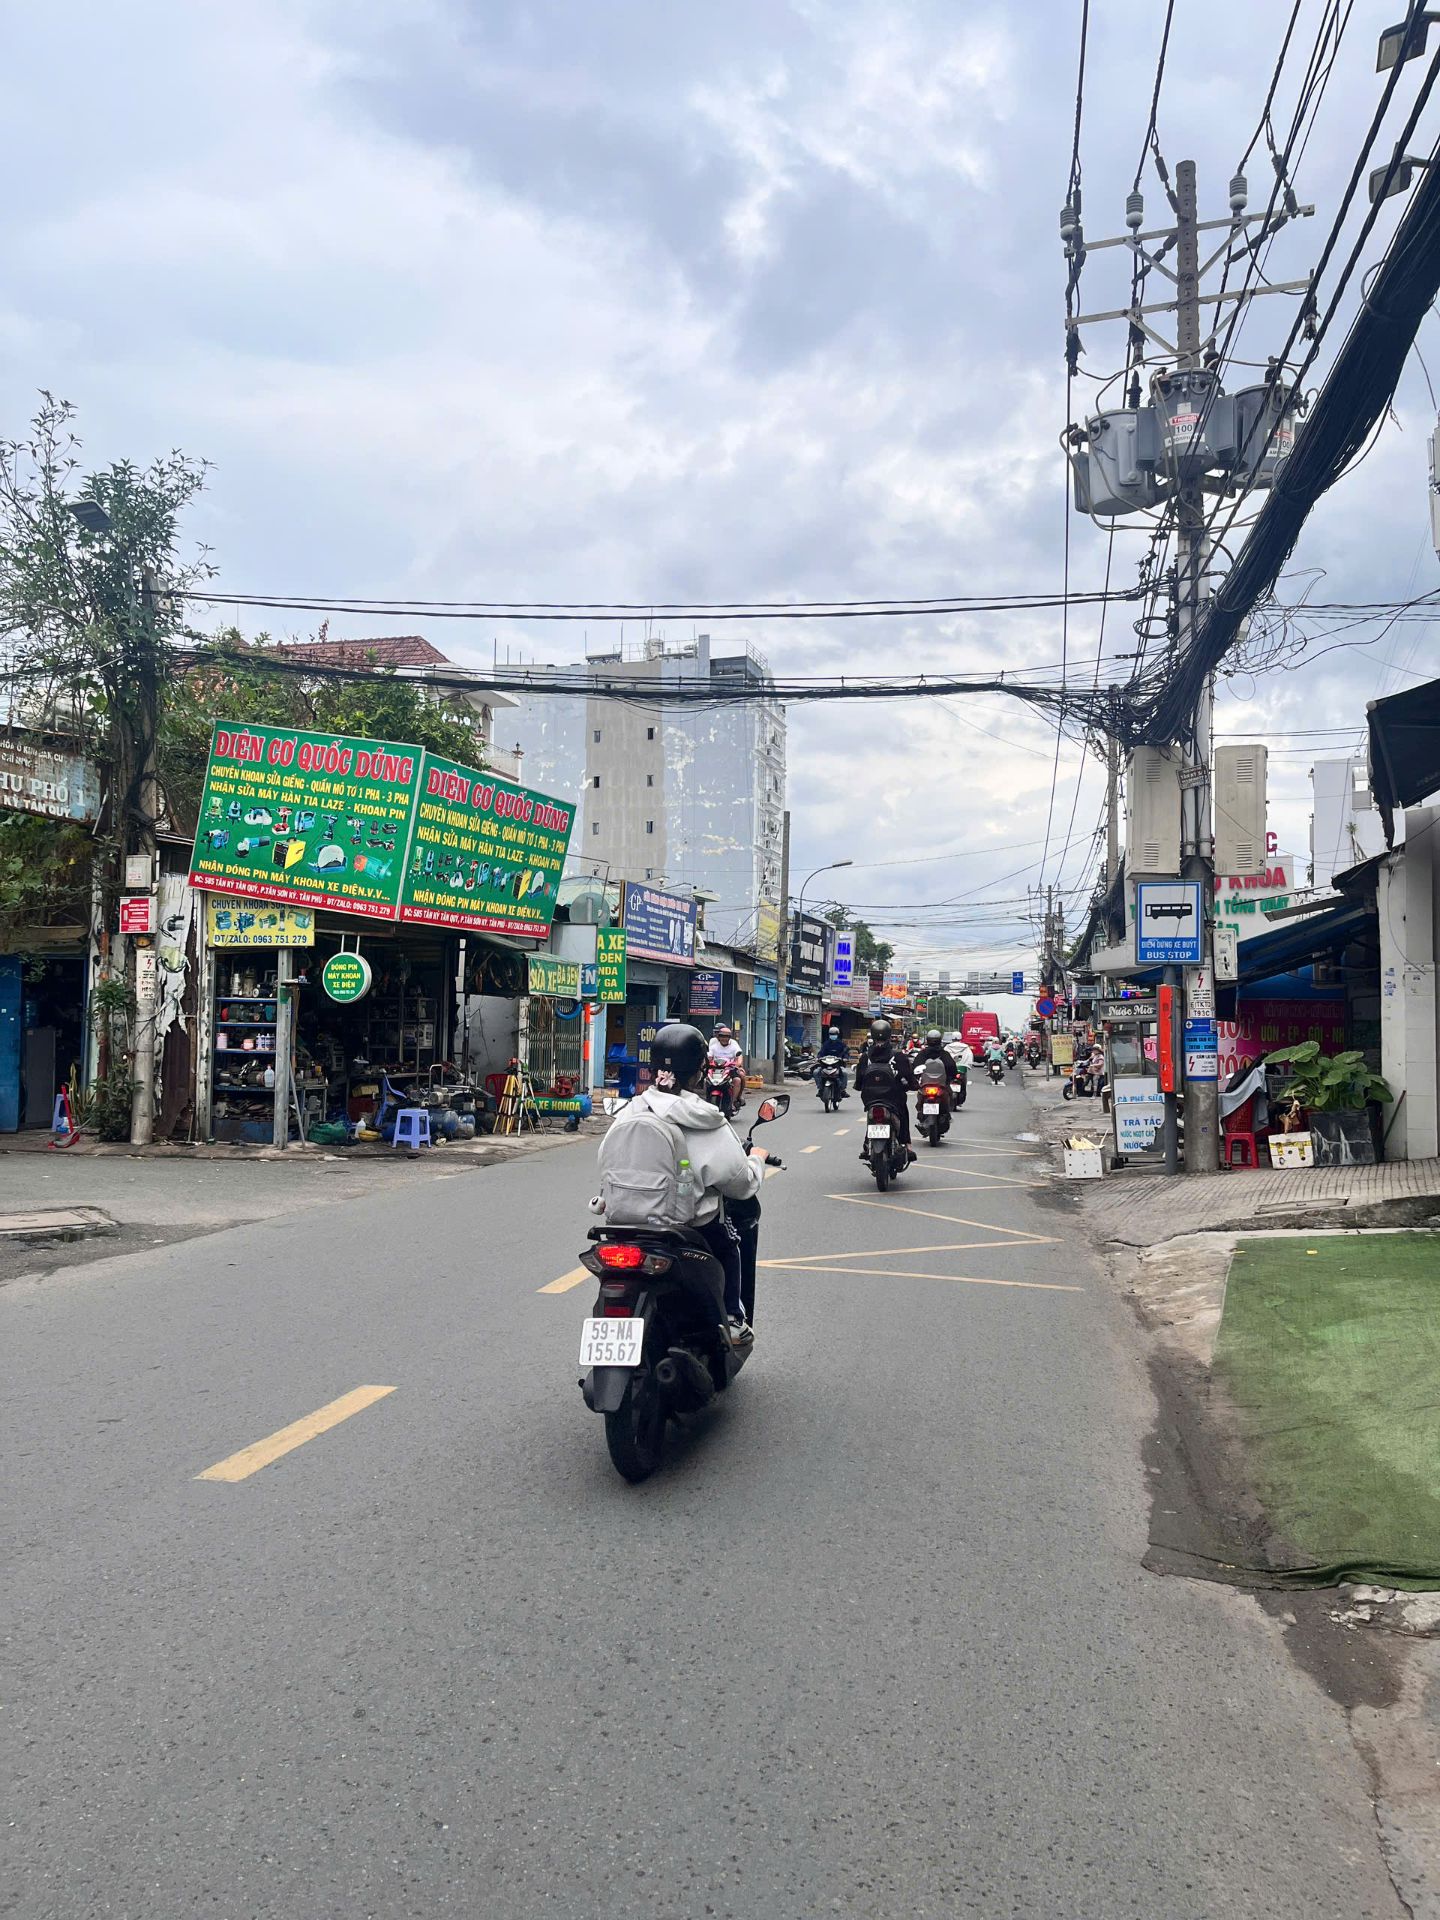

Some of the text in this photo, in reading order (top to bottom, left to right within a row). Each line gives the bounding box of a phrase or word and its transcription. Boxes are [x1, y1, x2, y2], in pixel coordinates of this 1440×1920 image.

[1176, 424, 1192, 434] 100
[214, 728, 266, 767] ĐIỆN
[267, 736, 298, 768] CƠ
[298, 740, 353, 776] QUỐC
[30, 778, 68, 802] PHỐ
[211, 765, 240, 780] CHUYÊN
[240, 769, 266, 784] KHOAN
[266, 770, 281, 786] SỬA
[282, 774, 305, 790] GIẾNG
[311, 778, 332, 794] QUẤN
[333, 782, 344, 796] MÔ
[358, 788, 363, 798] 1
[365, 788, 380, 801] PHA
[387, 792, 393, 803] 3
[394, 792, 410, 806] PHA
[426, 767, 471, 806] ĐIỆN
[472, 782, 496, 811] CƠ
[494, 790, 533, 822] QUỐC
[24, 798, 46, 814] TÂN
[210, 781, 406, 820] NHẬN SỬA MÁY HÀN TIA LAZE KHOAN PIN
[420, 802, 447, 823] CHUYÊN
[447, 810, 468, 829] KHOAN
[468, 812, 480, 832] SỬA
[481, 817, 499, 837] GIẾNG
[538, 836, 548, 850] PHA
[551, 840, 556, 852] 3
[417, 826, 561, 870] NHẬN SỬA MÁY HÀN TIA LAZE KHOAN PIN
[198, 860, 224, 873] NHẬN
[226, 864, 250, 877] ĐÓNG
[252, 868, 269, 880] PIN
[270, 871, 291, 884] MÁY
[293, 876, 325, 889] KHOAN
[327, 882, 339, 892] XE
[204, 876, 214, 885] 585
[216, 877, 226, 886] TÂN
[235, 880, 246, 890] TÂN
[277, 889, 288, 898] SƠN
[299, 892, 310, 901] TÂN
[311, 894, 323, 903] PHÚ
[353, 902, 367, 911] 0963
[368, 905, 378, 913] 751
[380, 906, 391, 915] 279
[413, 888, 434, 906] NHẬN
[436, 893, 455, 907] ĐÓNG
[457, 897, 468, 909] PIN
[470, 898, 484, 912] MÁY
[486, 901, 507, 914] KHOAN
[508, 904, 516, 916] XE
[424, 910, 432, 919] TÂN
[440, 913, 449, 921] TÂN
[214, 934, 307, 944] ĐT/ZALO: 0963 751 279
[608, 934, 625, 950] XE
[600, 953, 622, 963] ĐEN
[1147, 951, 1192, 959] BUS STOP
[530, 962, 546, 990] SỬA
[547, 970, 557, 992] XE
[598, 967, 618, 975] NDA
[604, 979, 617, 987] GA
[539, 1100, 580, 1111] XE HONDA
[1123, 1117, 1140, 1126] TRÀ
[592, 1321, 633, 1340] 59-NA
[588, 1342, 637, 1361] 155.67
